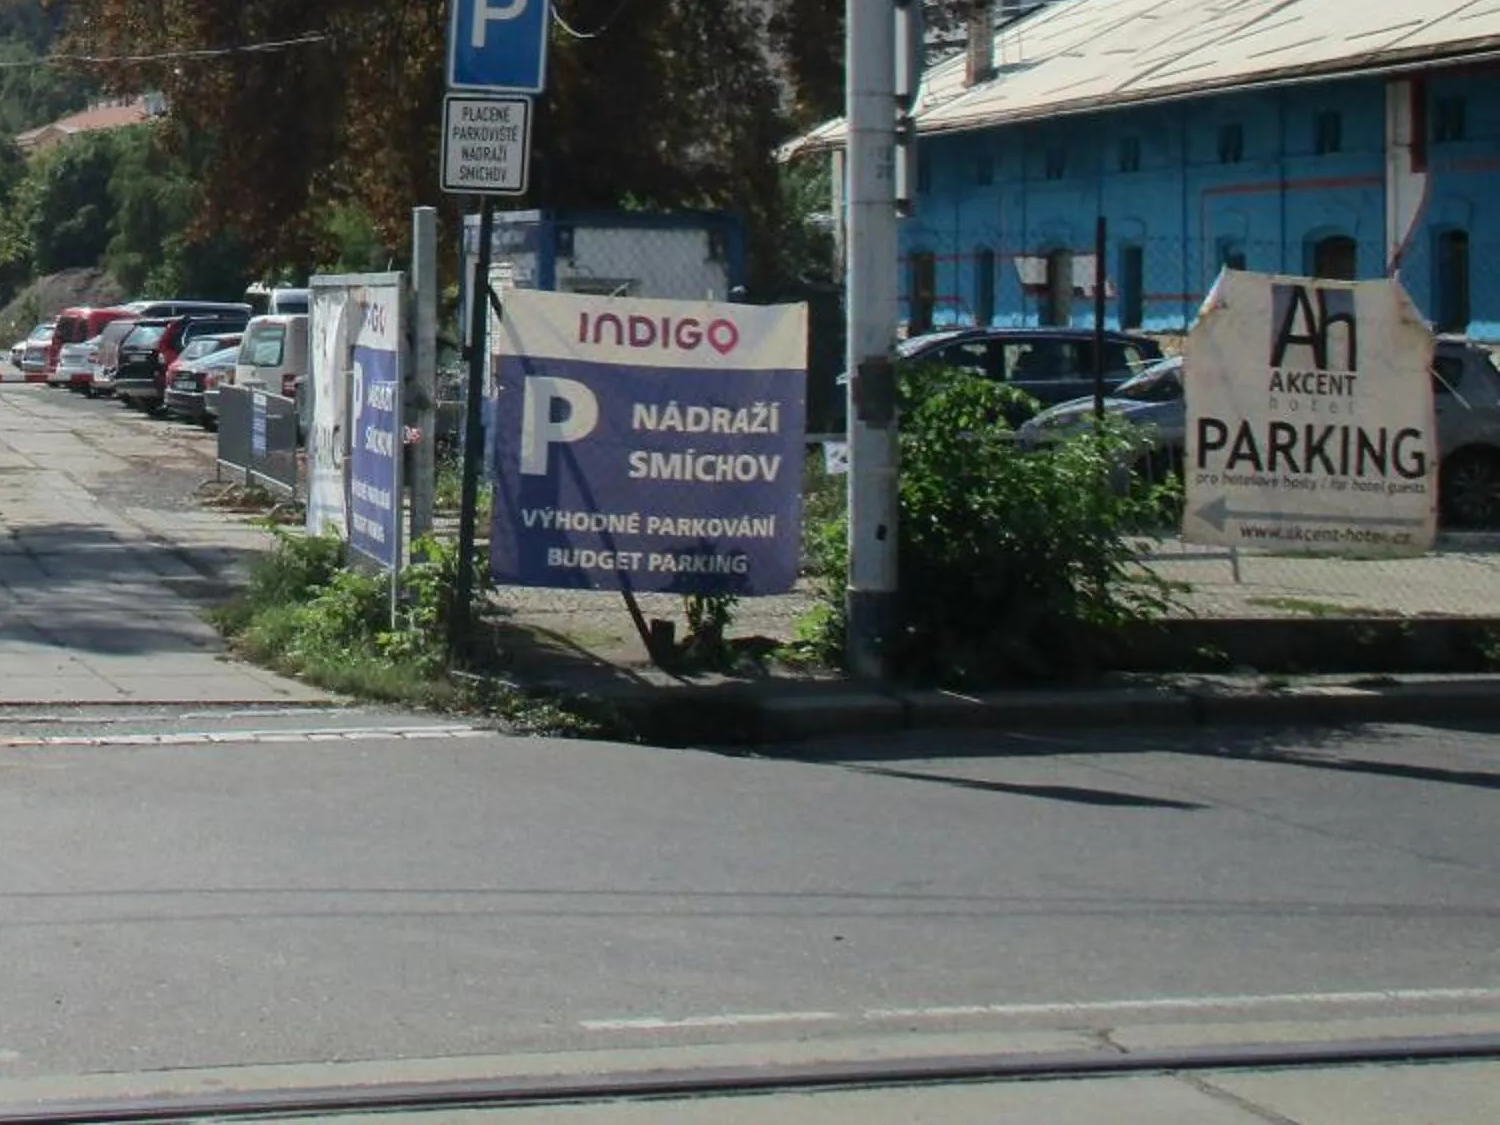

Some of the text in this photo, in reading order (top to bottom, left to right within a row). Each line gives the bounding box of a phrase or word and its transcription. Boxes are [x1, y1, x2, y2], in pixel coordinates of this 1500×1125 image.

[579, 311, 739, 356] INDIGO
[1269, 372, 1357, 396] AKCENT
[632, 400, 781, 434] NÁDRAŽÍ
[1269, 397, 1355, 414] hotel
[519, 376, 599, 476] P
[1197, 417, 1425, 479] PARKING
[628, 448, 782, 483] SMÍCHOV
[522, 506, 776, 538] VÝHODNÉ PARKOVÁNÍ
[547, 547, 749, 574] BUDGET PARKING
